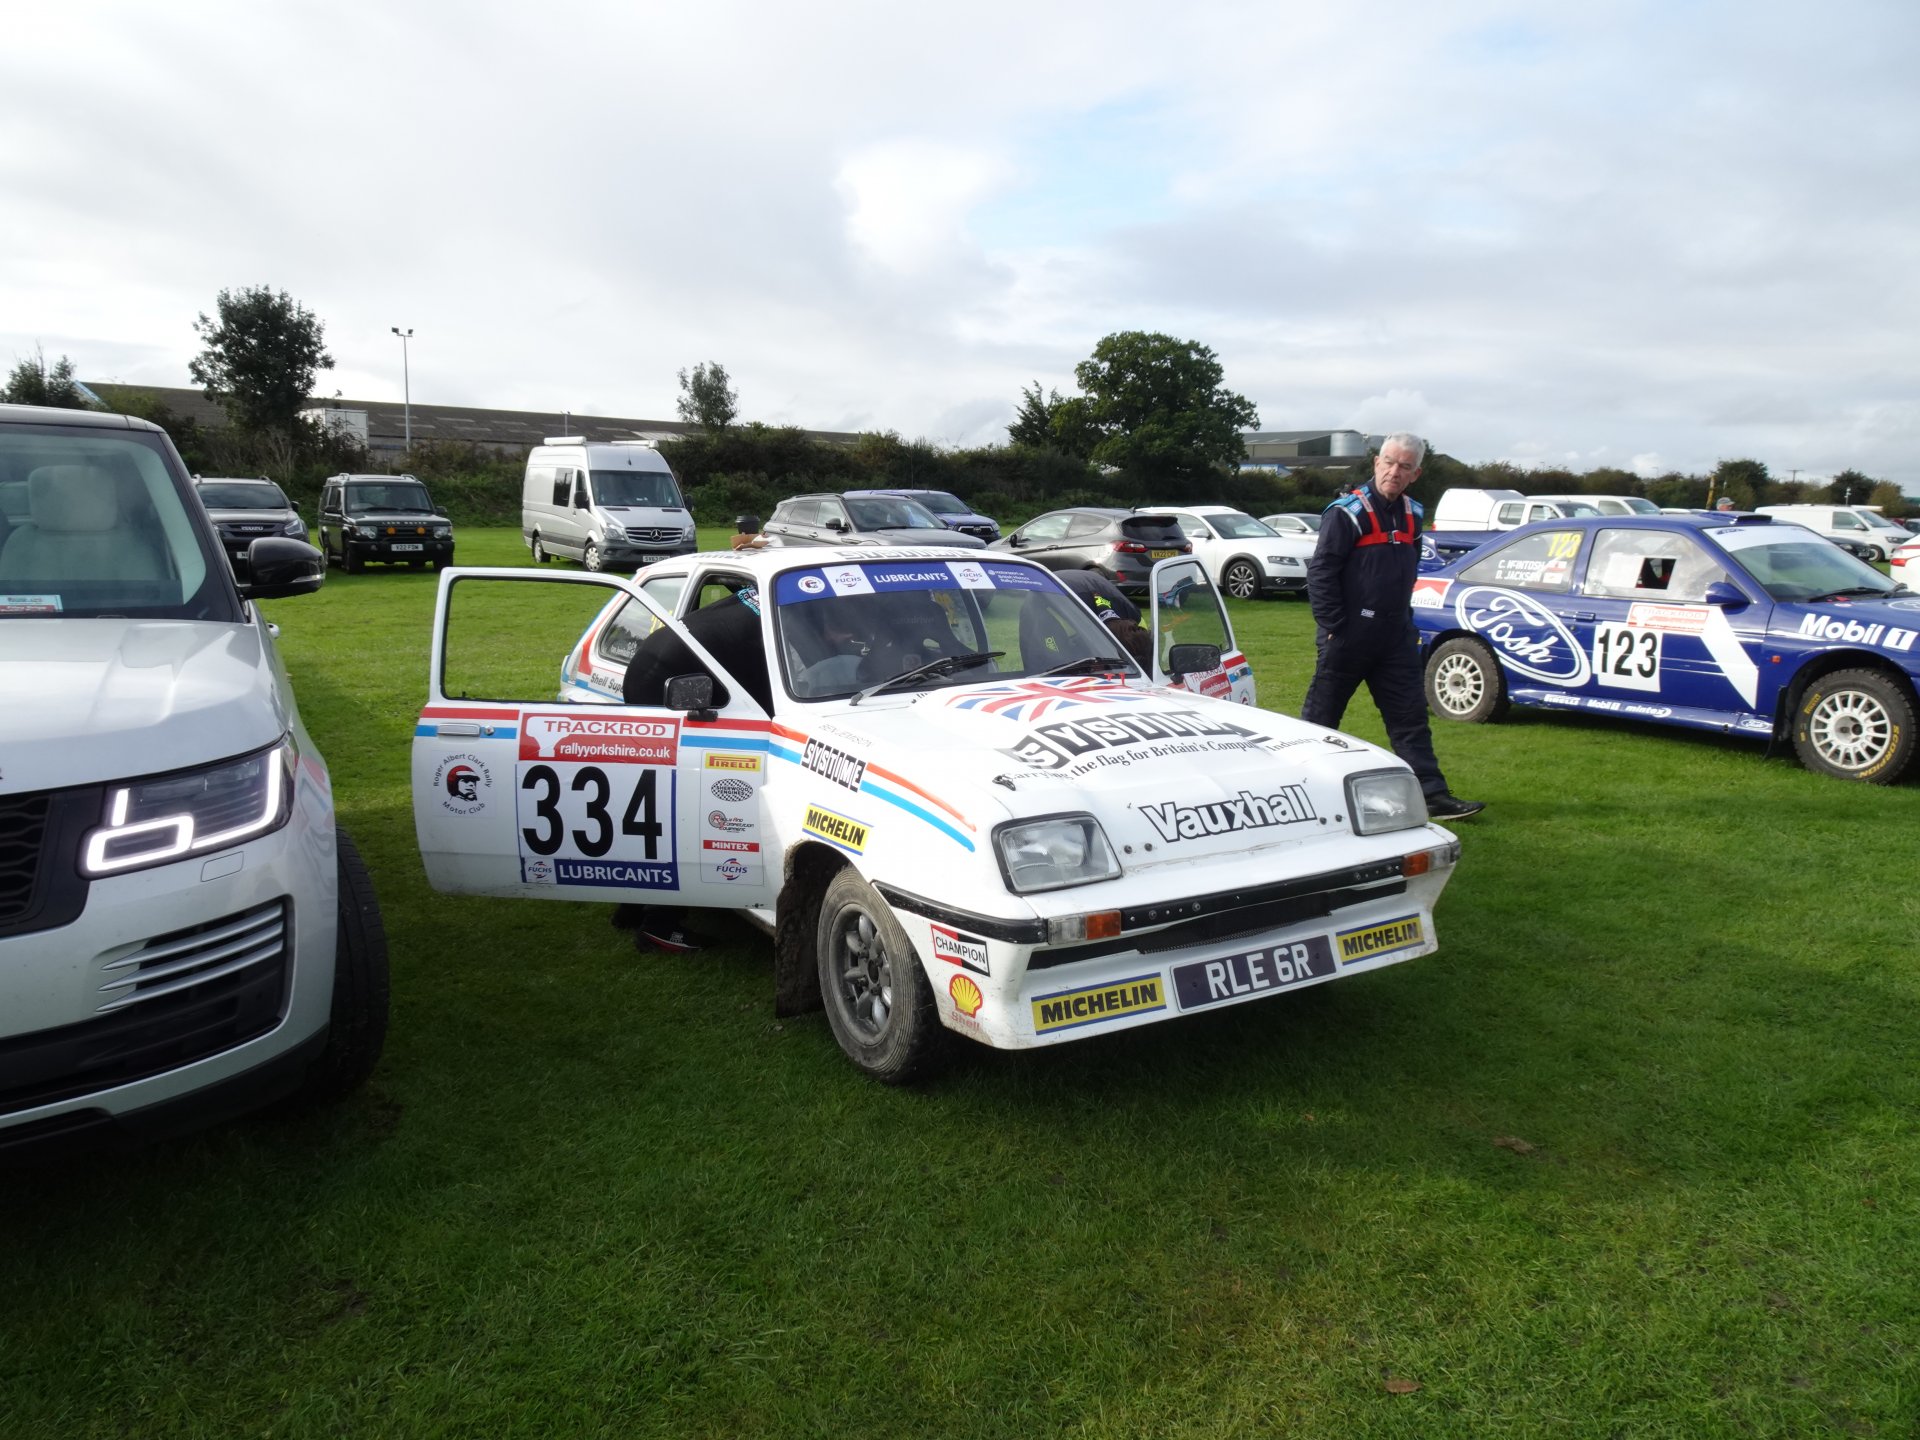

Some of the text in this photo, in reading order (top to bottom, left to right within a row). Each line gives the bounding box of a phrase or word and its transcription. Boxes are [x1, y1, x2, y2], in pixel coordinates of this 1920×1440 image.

[1547, 532, 1583, 559] 123
[835, 576, 862, 584] FUCHS
[873, 572, 949, 583] LUBRICANTS
[959, 571, 983, 579] FUCHS
[1470, 596, 1559, 663] Tosh
[1799, 613, 1885, 645] Mobil
[1598, 628, 1658, 679] 123
[590, 672, 609, 688] Shell
[1586, 699, 1612, 710] Mobil
[1625, 704, 1665, 716] mintex
[543, 720, 667, 737] TRACKROD
[560, 742, 671, 759] rallyyorkshire.co.uk
[1071, 761, 1098, 777] the
[1095, 753, 1131, 767] flag
[1126, 749, 1151, 761] for
[1149, 741, 1209, 757] Britain's
[1855, 724, 1900, 779] SCORPION
[433, 753, 493, 788] Roger Albert Clark Rally
[709, 755, 757, 769] PIRELLI
[442, 801, 486, 815] Motor Club
[521, 764, 663, 860] 334
[1138, 784, 1317, 843] Vauxhall
[806, 809, 866, 847] MICHELIN
[711, 841, 749, 850] MINTEX
[528, 866, 553, 875] FUCHS
[558, 864, 673, 884] LUBRICANTS
[715, 865, 748, 874] FUCHS
[1341, 922, 1420, 956] MICHELIN
[935, 936, 986, 964] CHAMPION
[1205, 943, 1314, 1000] RLE 6R
[1040, 982, 1159, 1024] MICHELIN
[951, 1011, 980, 1032] Shell
